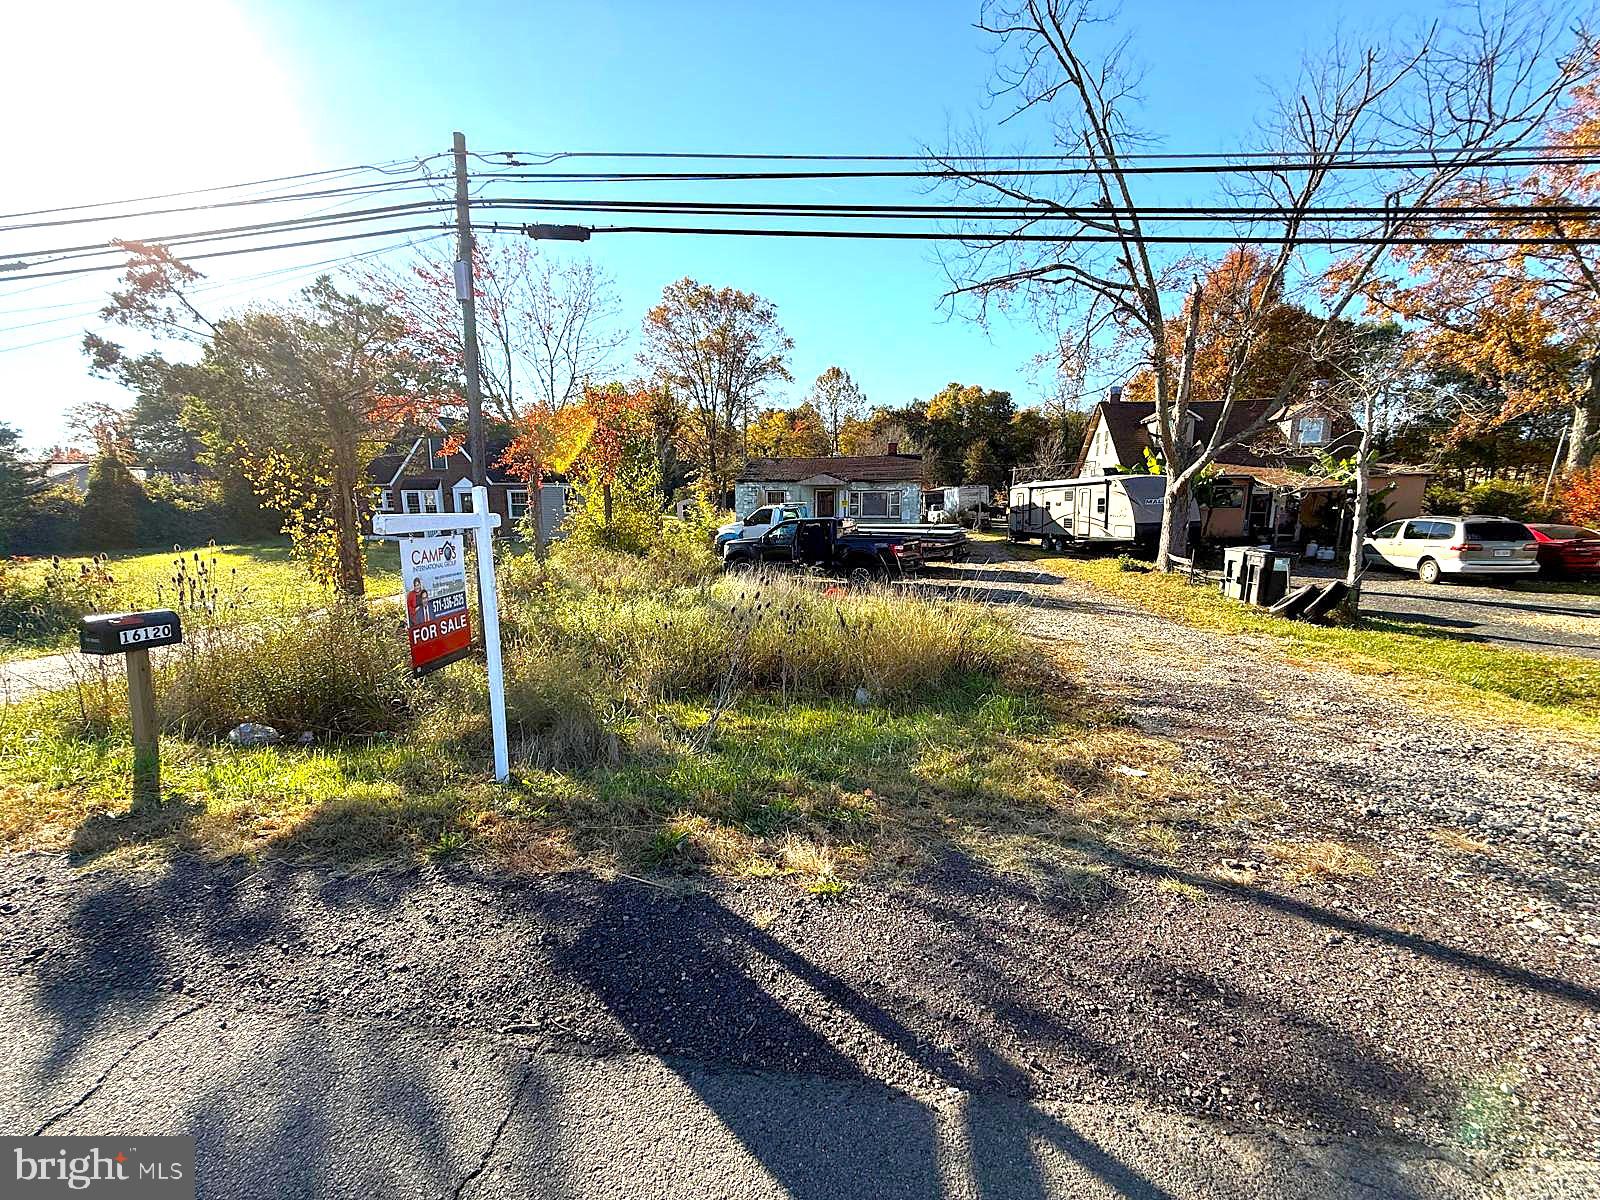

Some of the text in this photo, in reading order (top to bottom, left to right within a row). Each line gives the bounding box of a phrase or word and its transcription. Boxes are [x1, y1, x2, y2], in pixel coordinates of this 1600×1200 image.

[411, 545, 457, 565] CAMPOS
[412, 562, 443, 572] INTERNATIONAL
[123, 626, 171, 643] 16120
[413, 614, 467, 644] FOR SALE
